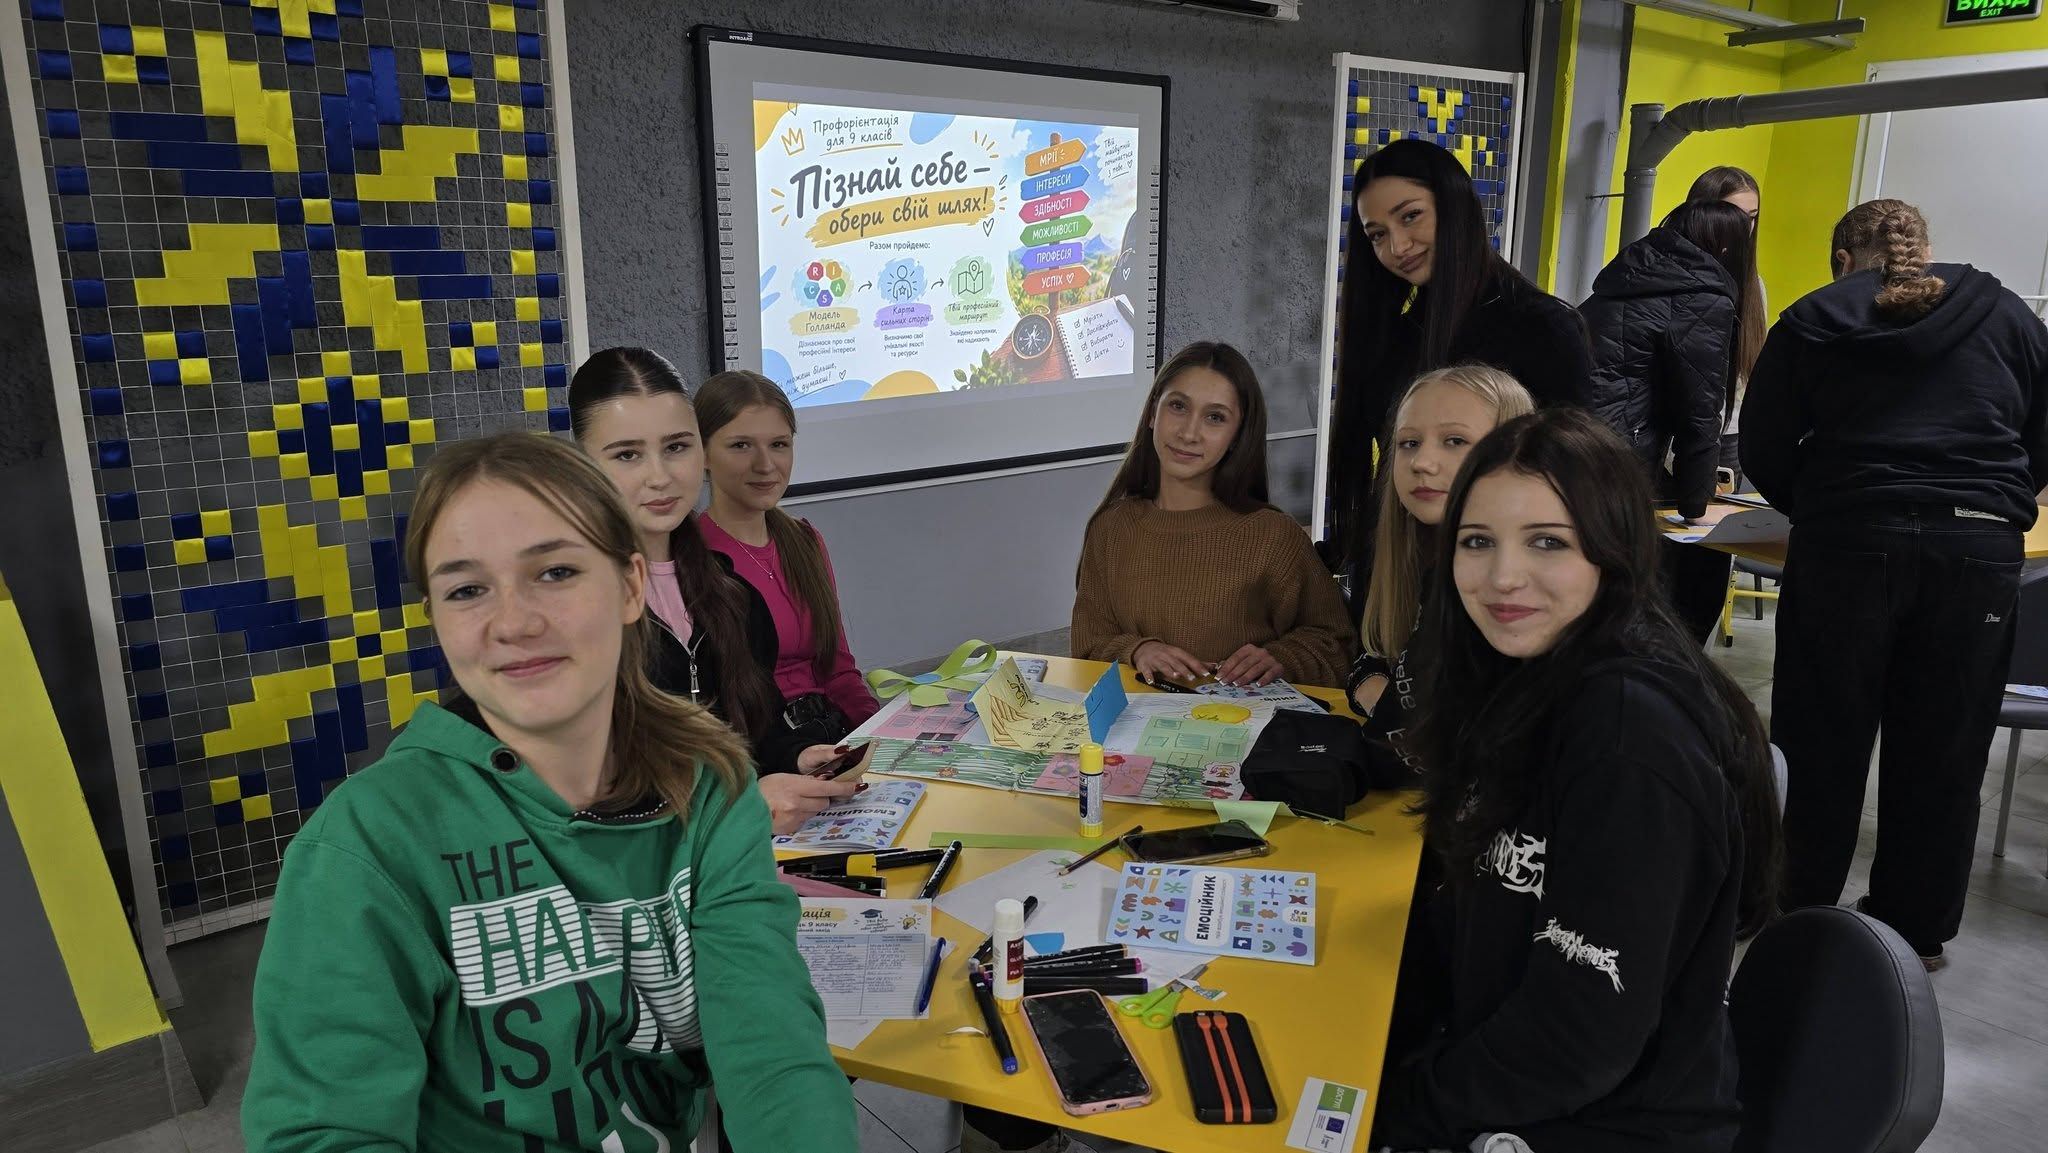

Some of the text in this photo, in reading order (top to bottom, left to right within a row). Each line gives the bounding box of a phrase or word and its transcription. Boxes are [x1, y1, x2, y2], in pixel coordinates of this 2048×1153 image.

[1980, 8, 2003, 17] EXIT
[813, 115, 899, 136] Профорієнтація
[827, 128, 893, 151] для 9 класів
[1040, 148, 1058, 166] МРІЇ
[789, 157, 902, 219] Пізнай
[911, 151, 968, 187] себе
[1036, 173, 1071, 192] ІНТЕРЕСИ
[829, 187, 989, 237] обери свій шлях!
[1034, 198, 1072, 217] ЗДІБНОСТІ
[1032, 221, 1079, 240] МОЖЛИВОСТІ
[869, 241, 931, 251] Разом пройдемо:
[1036, 248, 1072, 264] ПРОФЕСІЯ
[812, 268, 819, 276] R
[1041, 274, 1063, 288] УСПІХ
[808, 286, 815, 294] C
[835, 283, 842, 292] A
[822, 295, 828, 304] S
[892, 306, 915, 315] Карта
[948, 300, 999, 312] Твій професійний
[809, 311, 841, 321] Модель
[881, 315, 930, 327] сильних сторін
[959, 313, 988, 322] маршрут
[1083, 312, 1104, 325] Мріяти
[805, 322, 846, 333] Голланда
[897, 351, 918, 359] ресурси
[1094, 348, 1110, 360] Діяти
[816, 808, 897, 818] ЕМОЦІЙНИ
[440, 838, 539, 902] THE
[1196, 875, 1217, 940] ЕМОЦІЙНИК
[801, 908, 831, 920] ація
[468, 997, 551, 1094] IS
